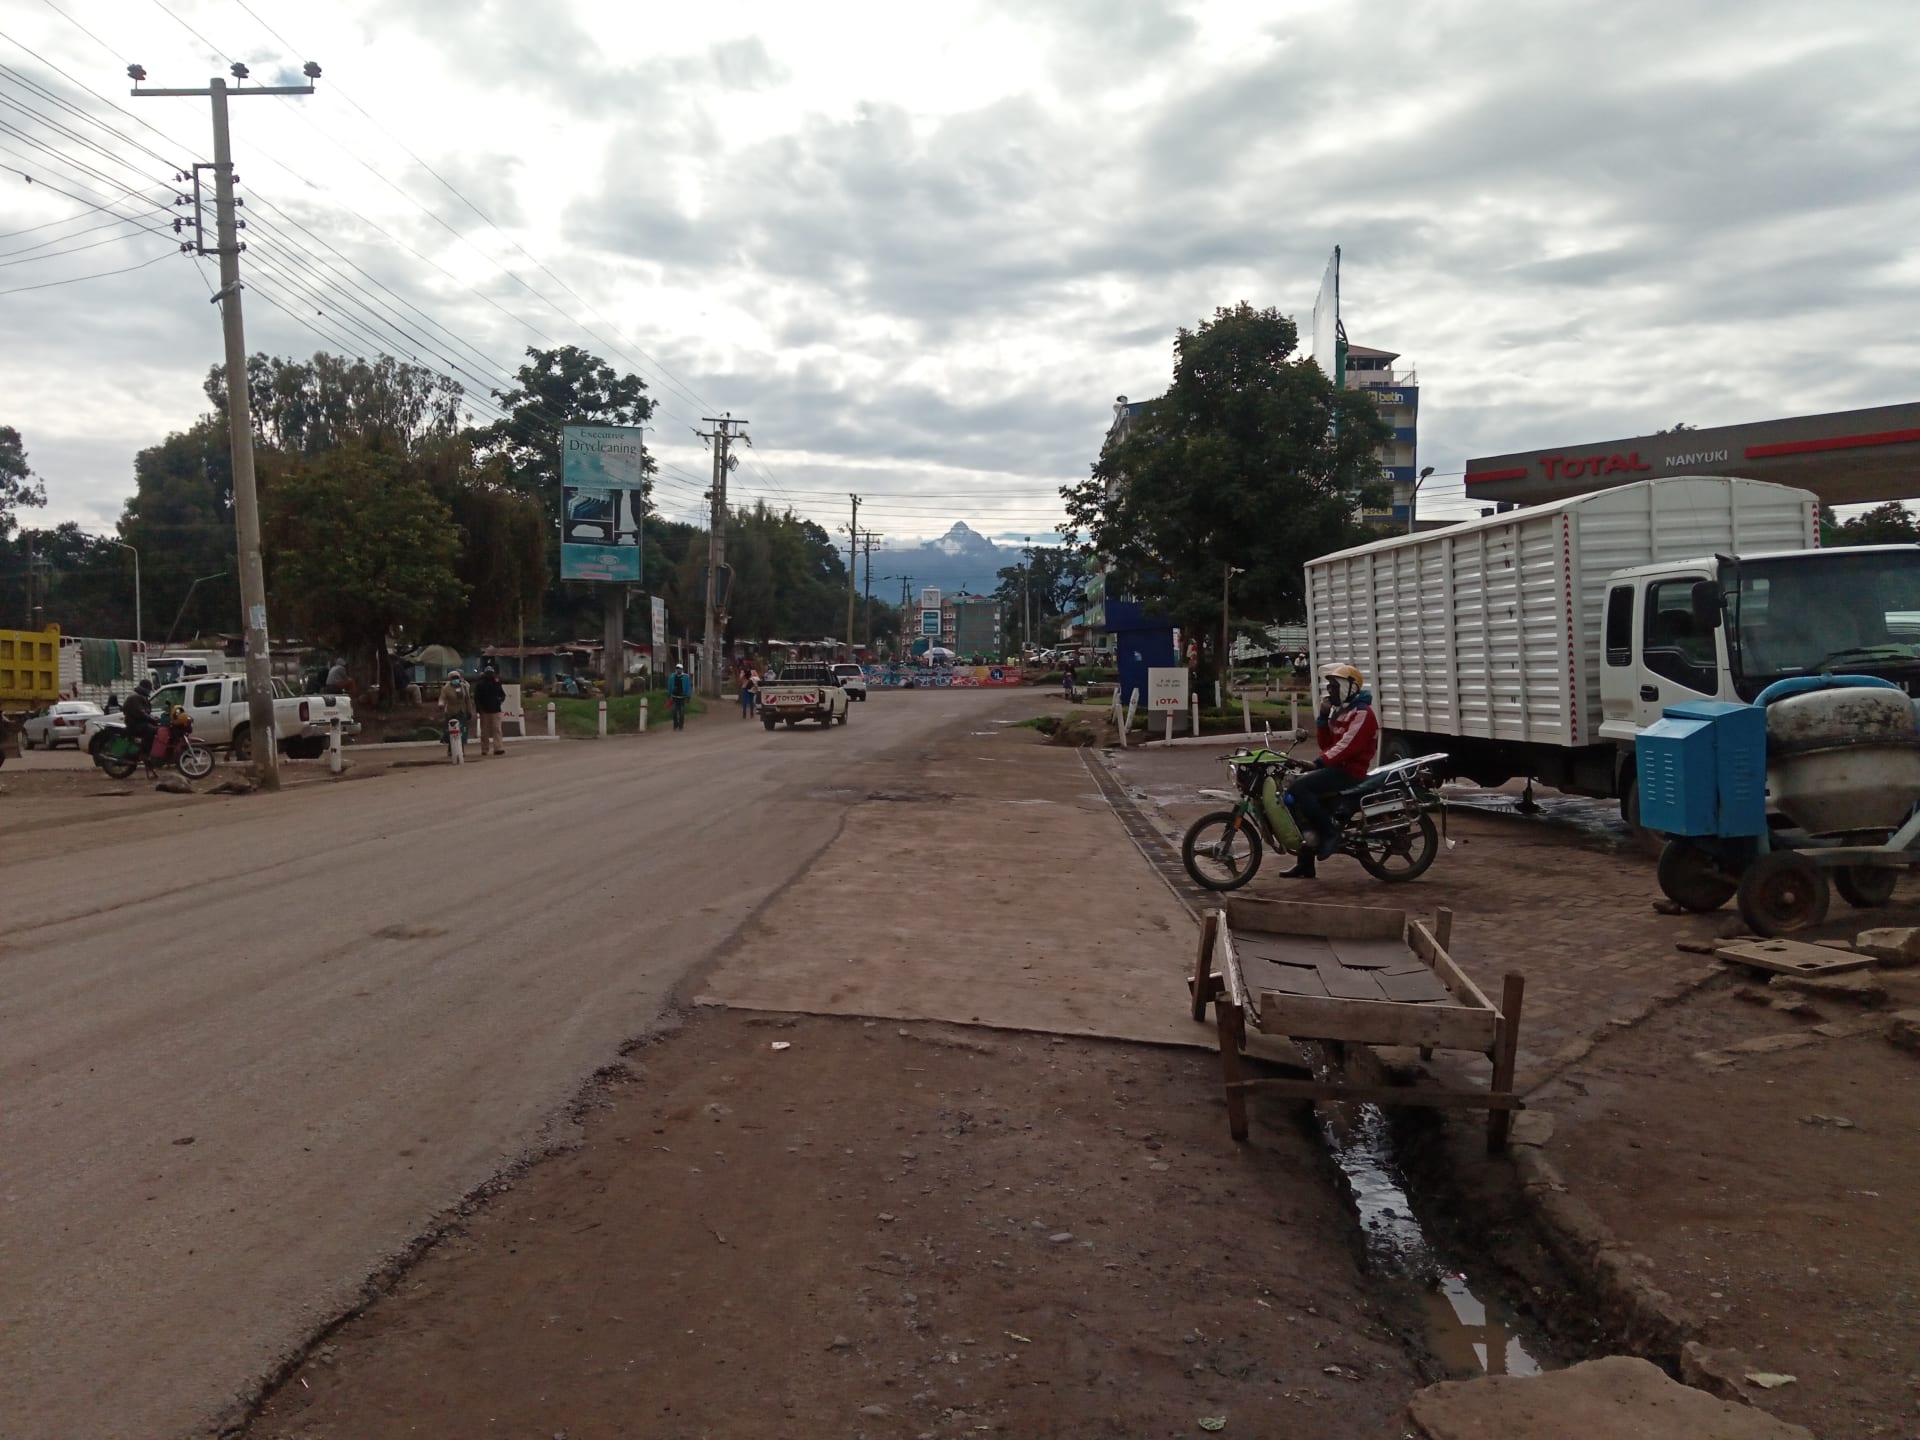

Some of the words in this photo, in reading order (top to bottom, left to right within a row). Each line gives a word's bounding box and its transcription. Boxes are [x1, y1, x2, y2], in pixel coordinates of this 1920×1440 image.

[580, 428, 625, 440] Executive
[570, 438, 637, 456] Drycleaning
[1539, 453, 1651, 480] TOTAL
[1665, 449, 1728, 467] NANYUKI
